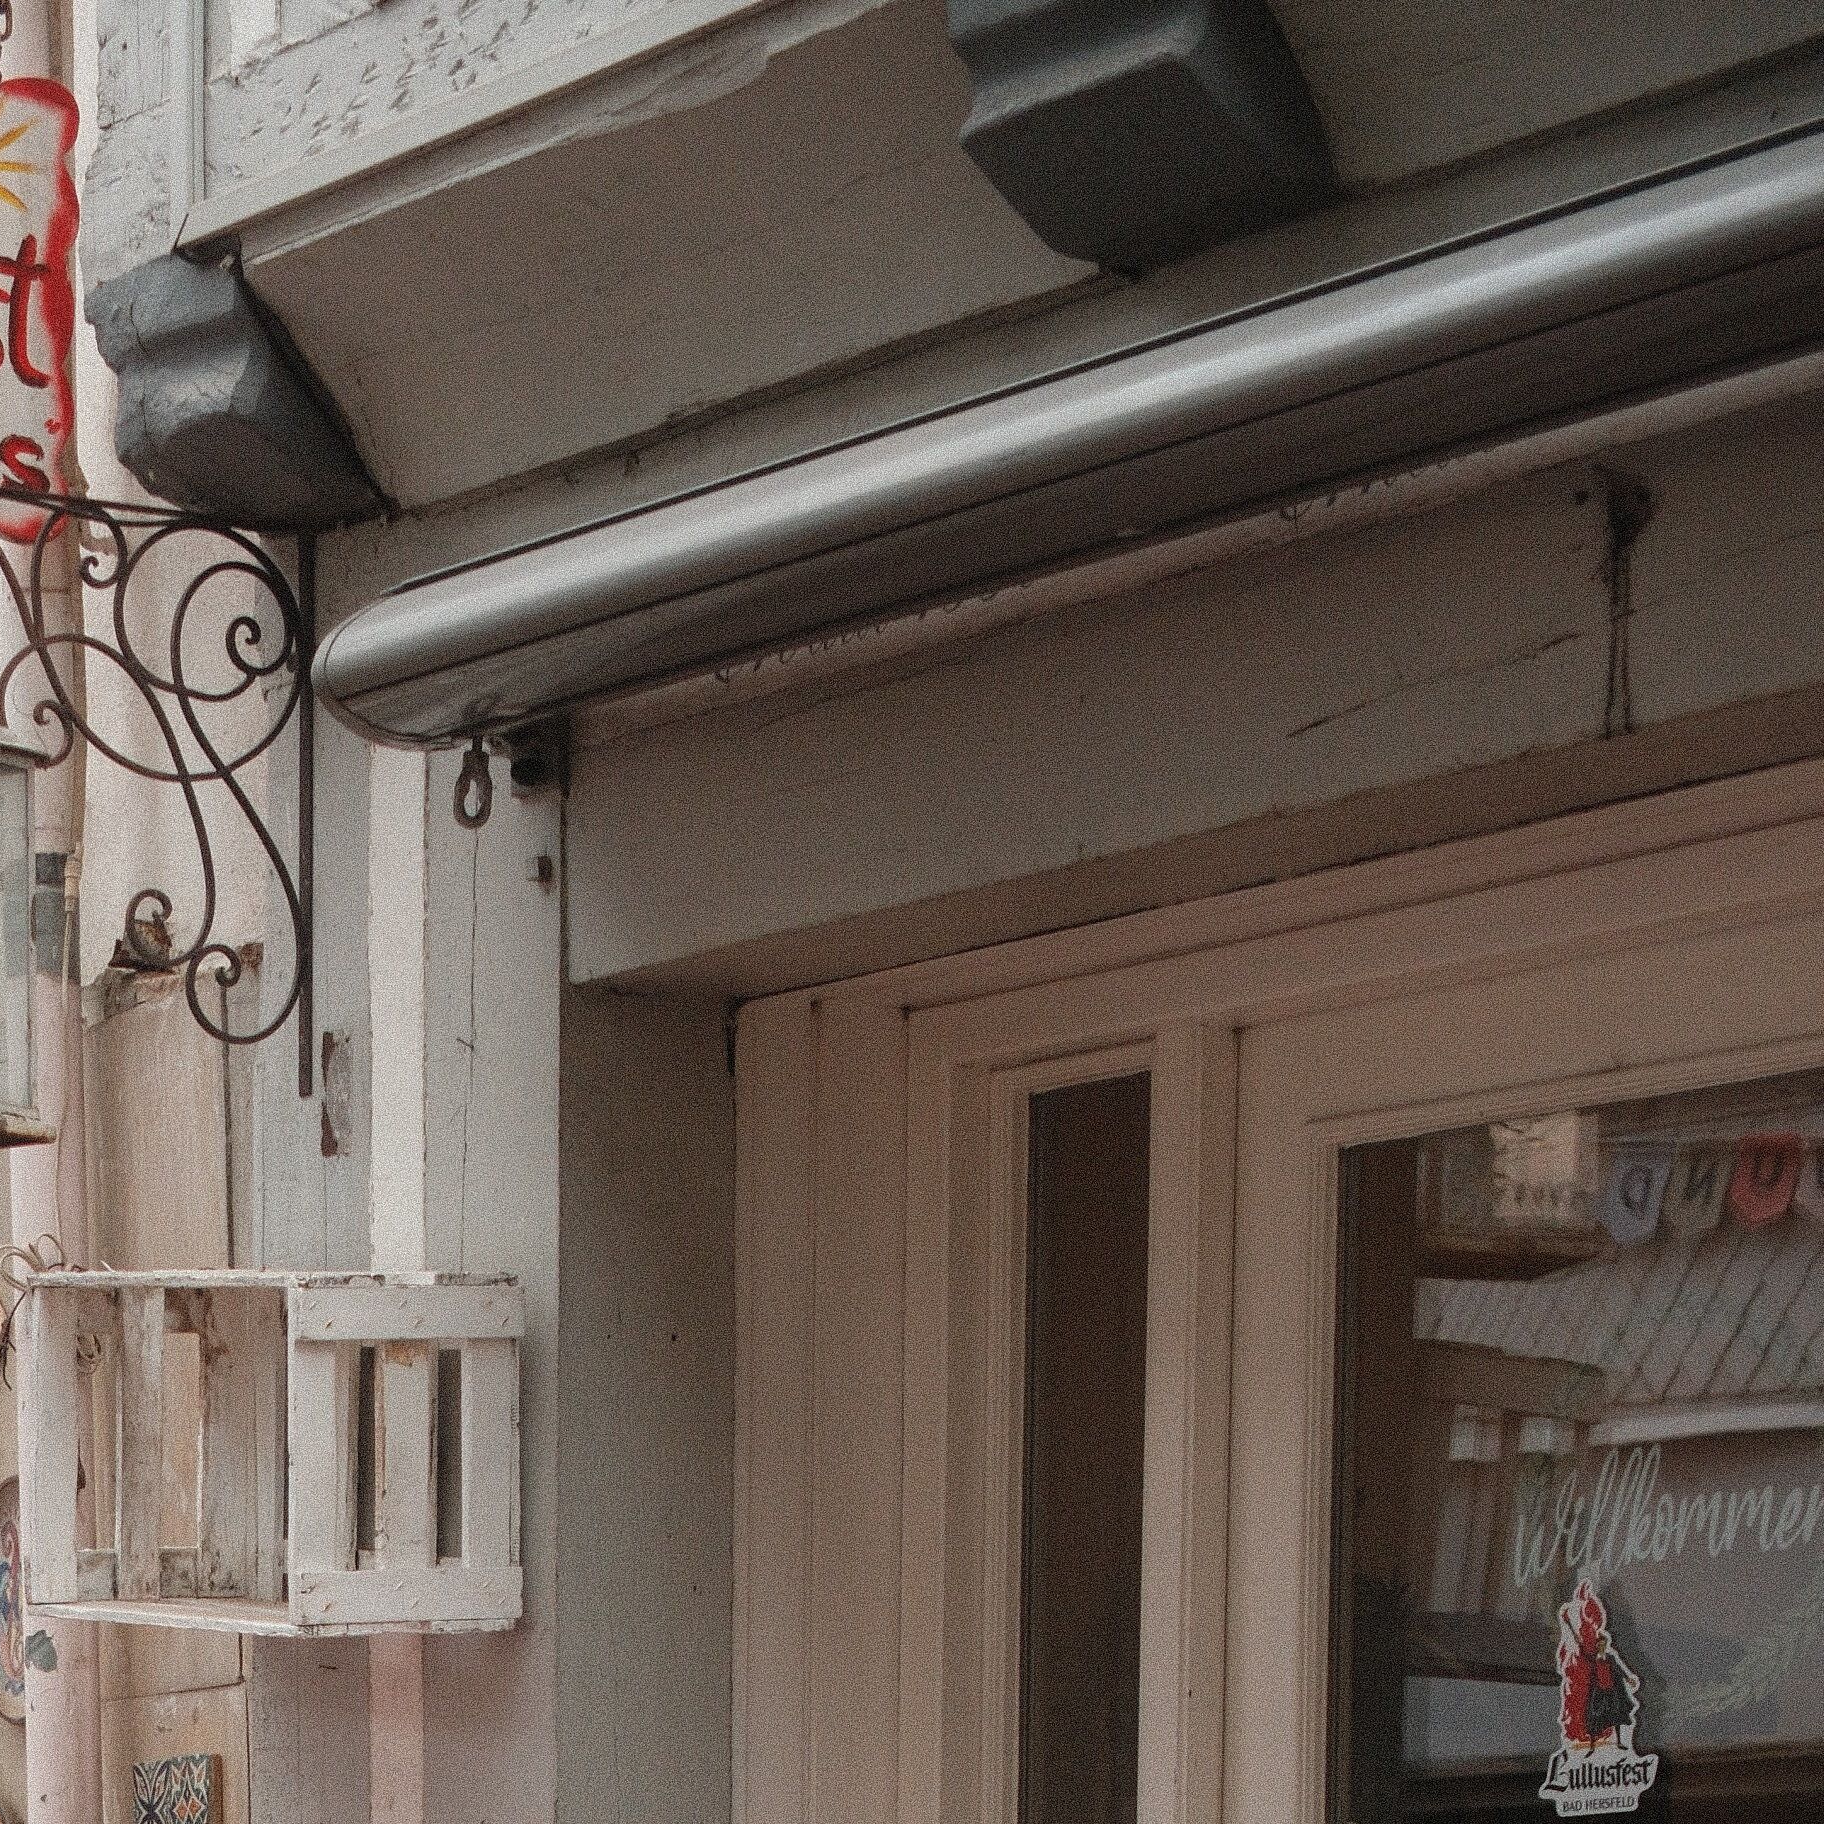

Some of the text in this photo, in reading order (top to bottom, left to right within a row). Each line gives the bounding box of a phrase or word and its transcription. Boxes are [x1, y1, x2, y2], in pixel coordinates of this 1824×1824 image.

[1545, 1750, 1654, 1792] Lullusfest
[1563, 1796, 1635, 1812] BAD HERSFELD
